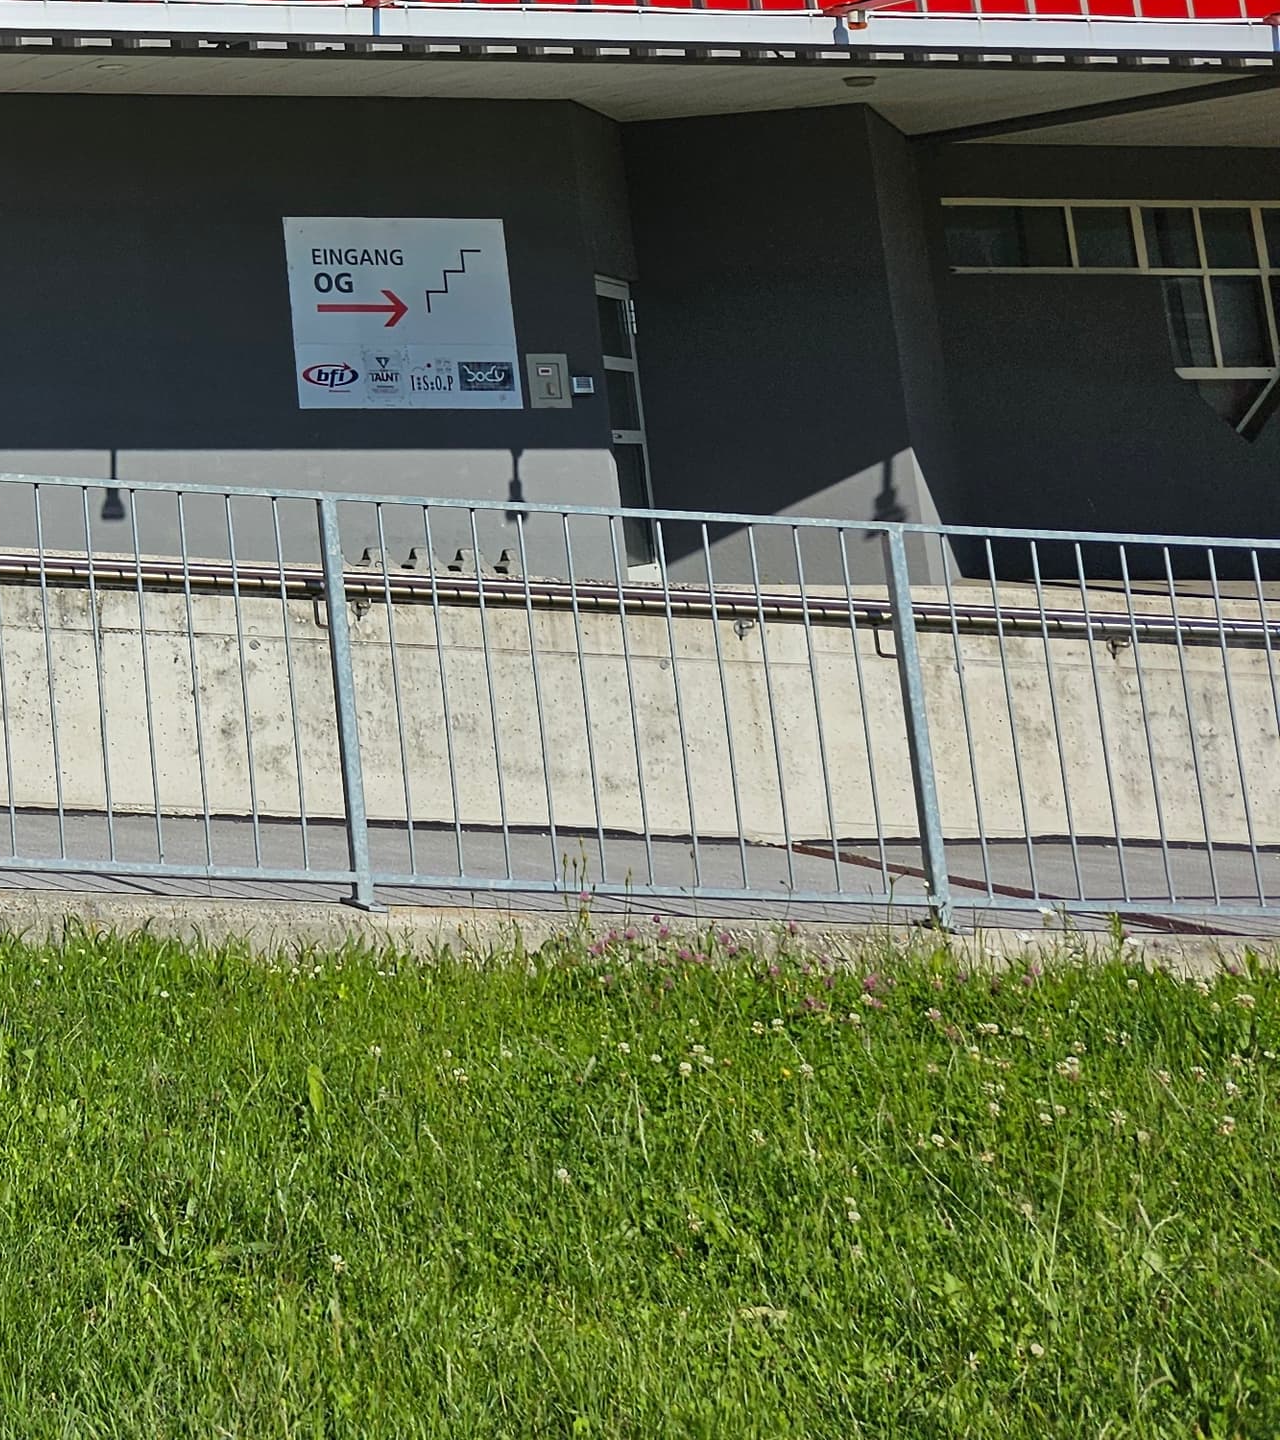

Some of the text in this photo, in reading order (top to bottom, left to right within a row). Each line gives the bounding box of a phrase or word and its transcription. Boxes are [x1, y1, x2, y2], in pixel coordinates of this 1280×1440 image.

[311, 248, 404, 266] EINGANG
[314, 272, 354, 293] OG
[316, 368, 345, 388] bfi
